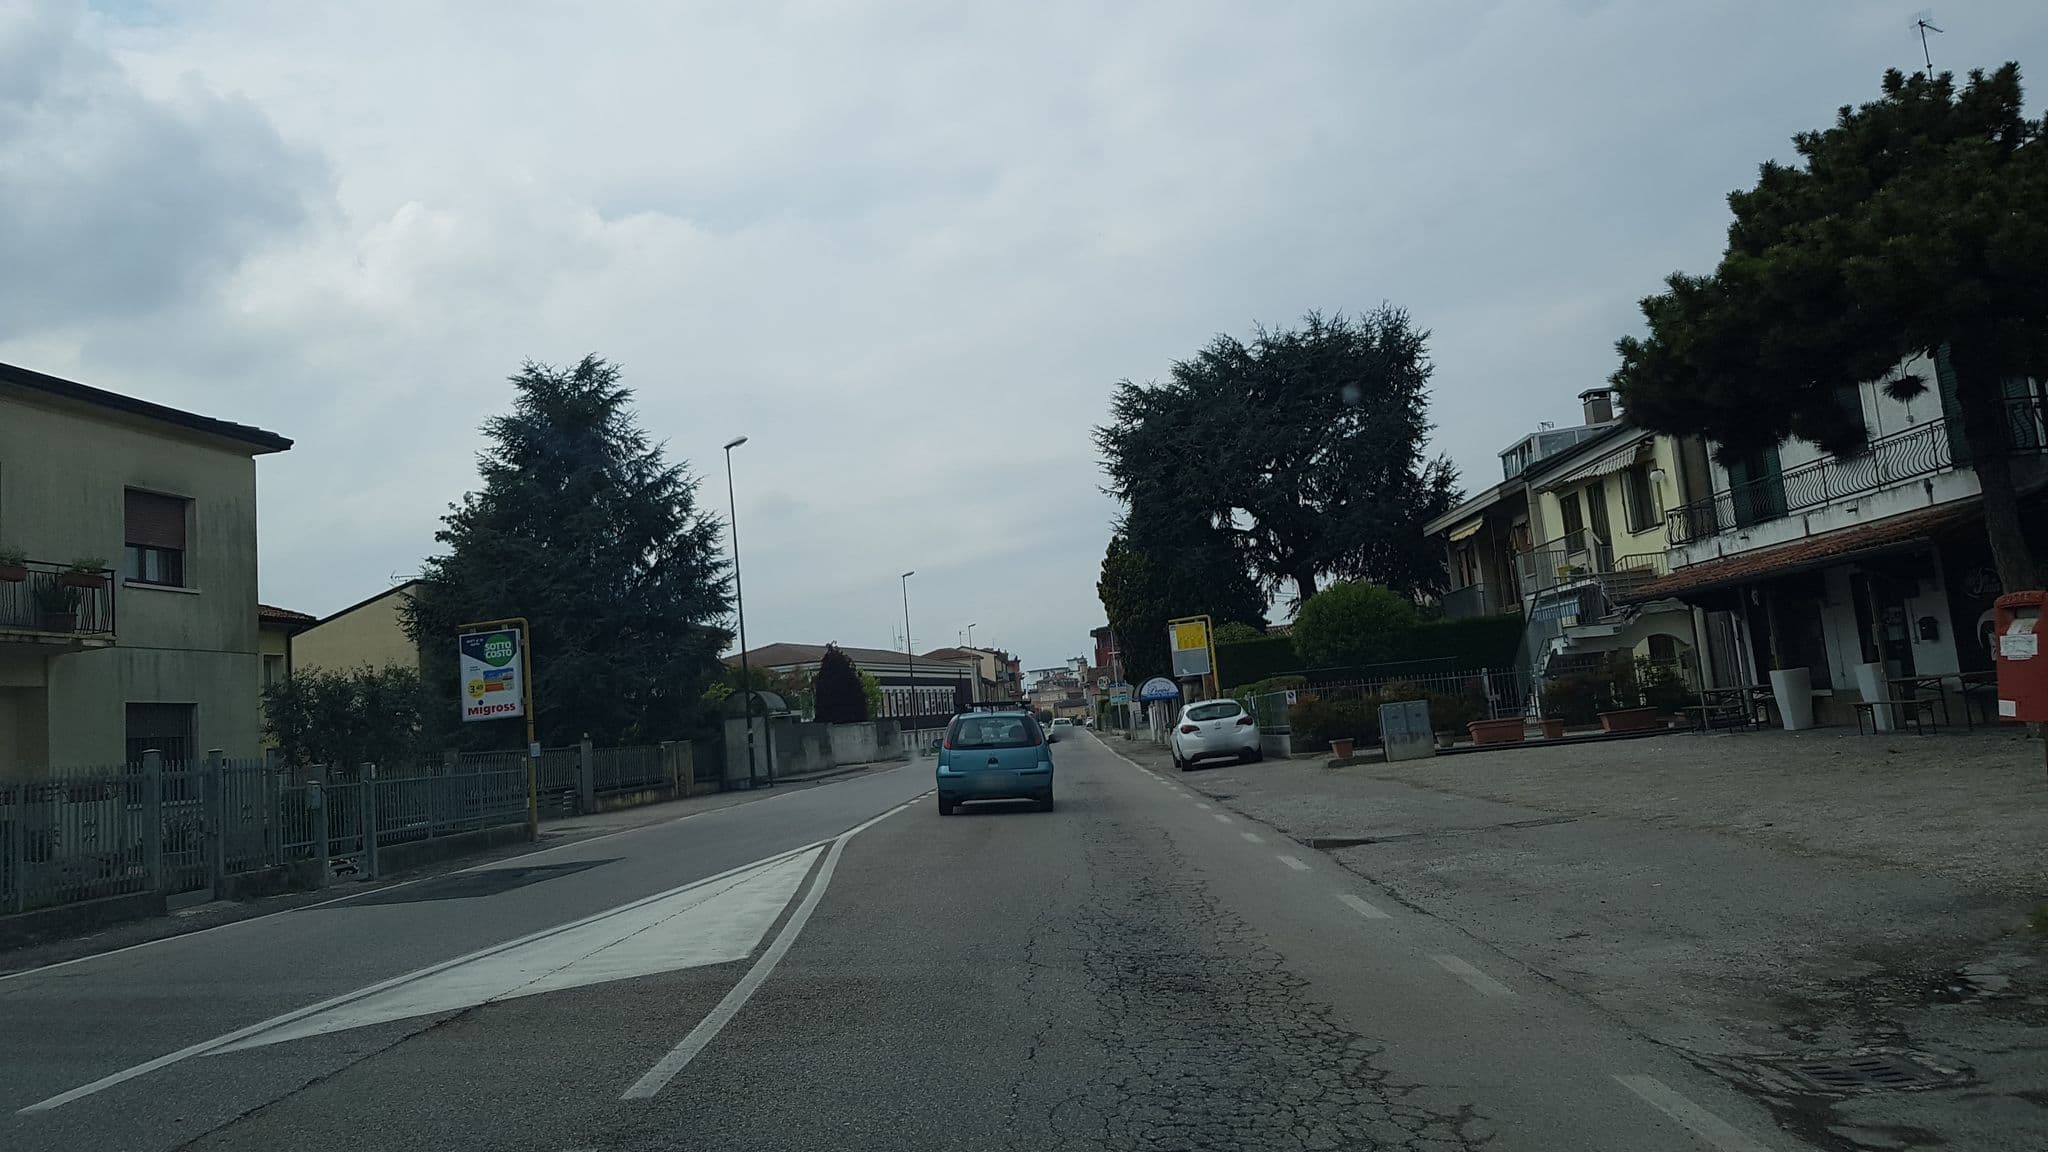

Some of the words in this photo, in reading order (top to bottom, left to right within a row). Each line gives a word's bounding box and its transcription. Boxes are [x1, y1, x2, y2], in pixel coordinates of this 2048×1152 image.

[484, 641, 512, 651] SOTTO
[485, 649, 513, 659] COSTO
[467, 700, 516, 716] Migross
